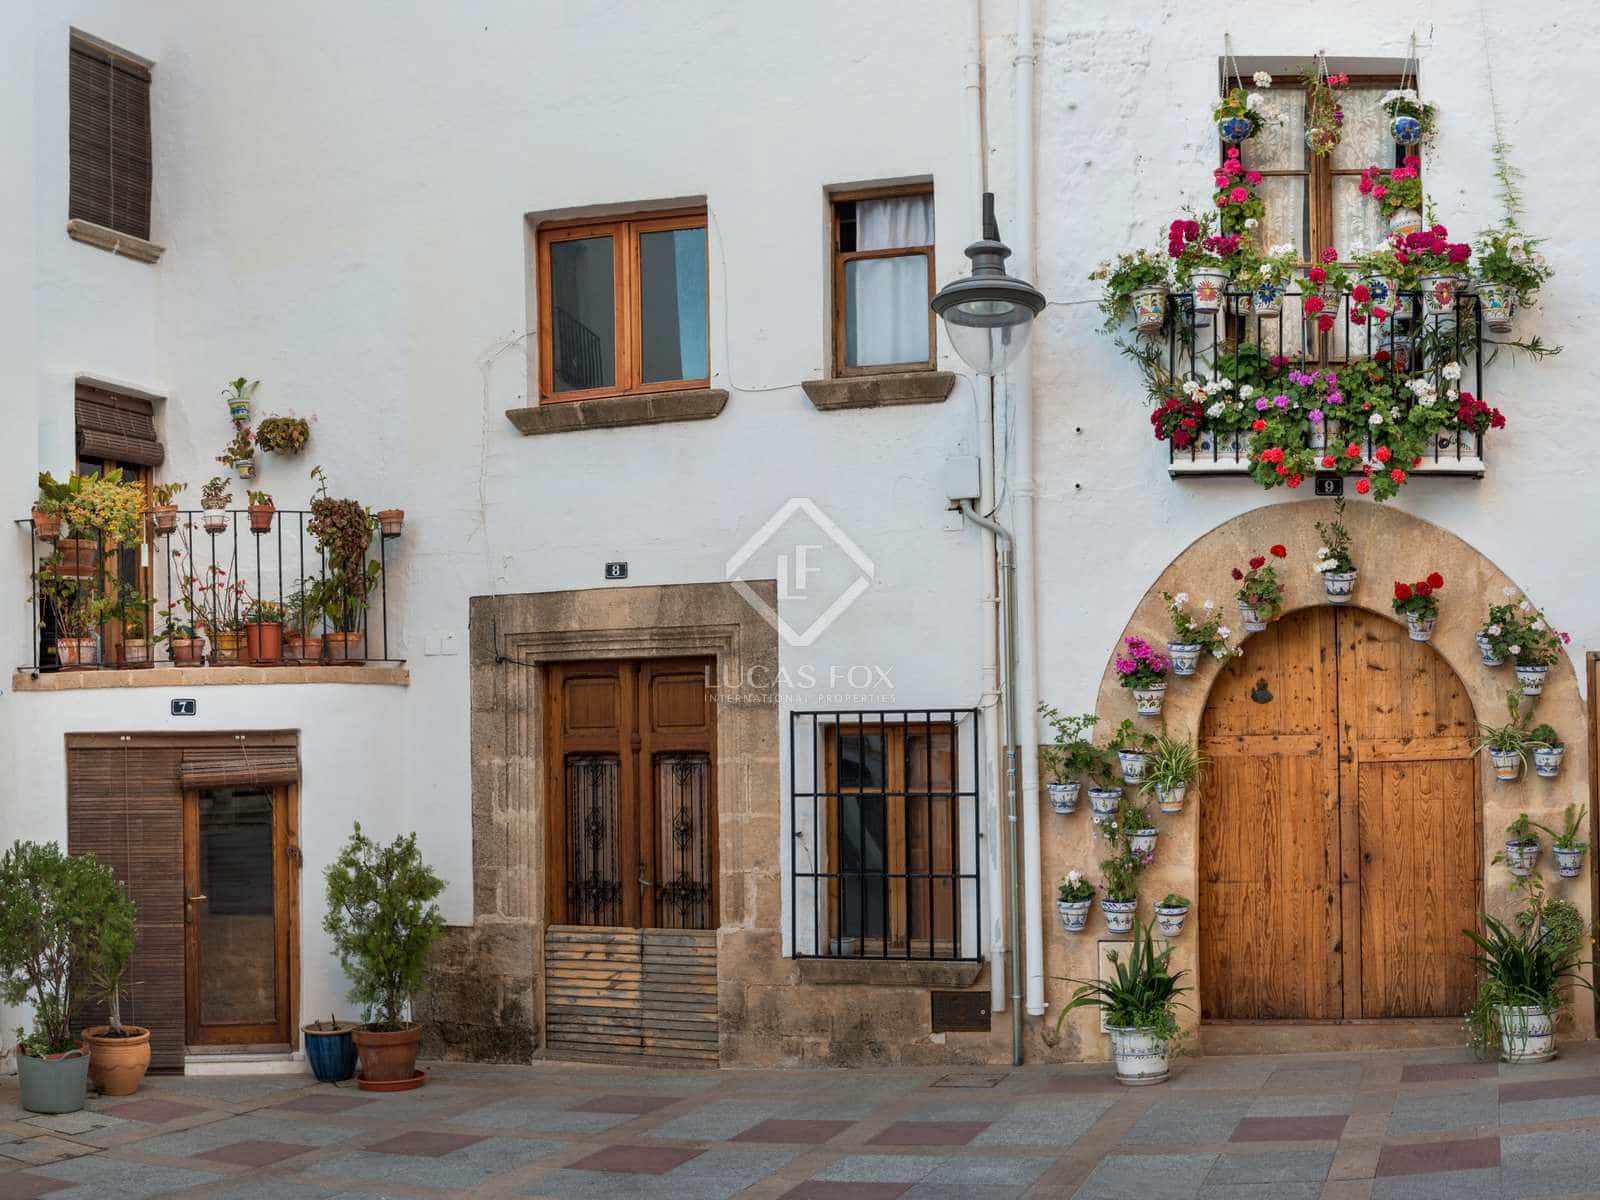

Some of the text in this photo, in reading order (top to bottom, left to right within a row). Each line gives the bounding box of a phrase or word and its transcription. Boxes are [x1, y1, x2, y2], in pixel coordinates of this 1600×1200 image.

[1324, 480, 1334, 493] 9
[612, 565, 620, 576] 8
[179, 701, 187, 713] 7
